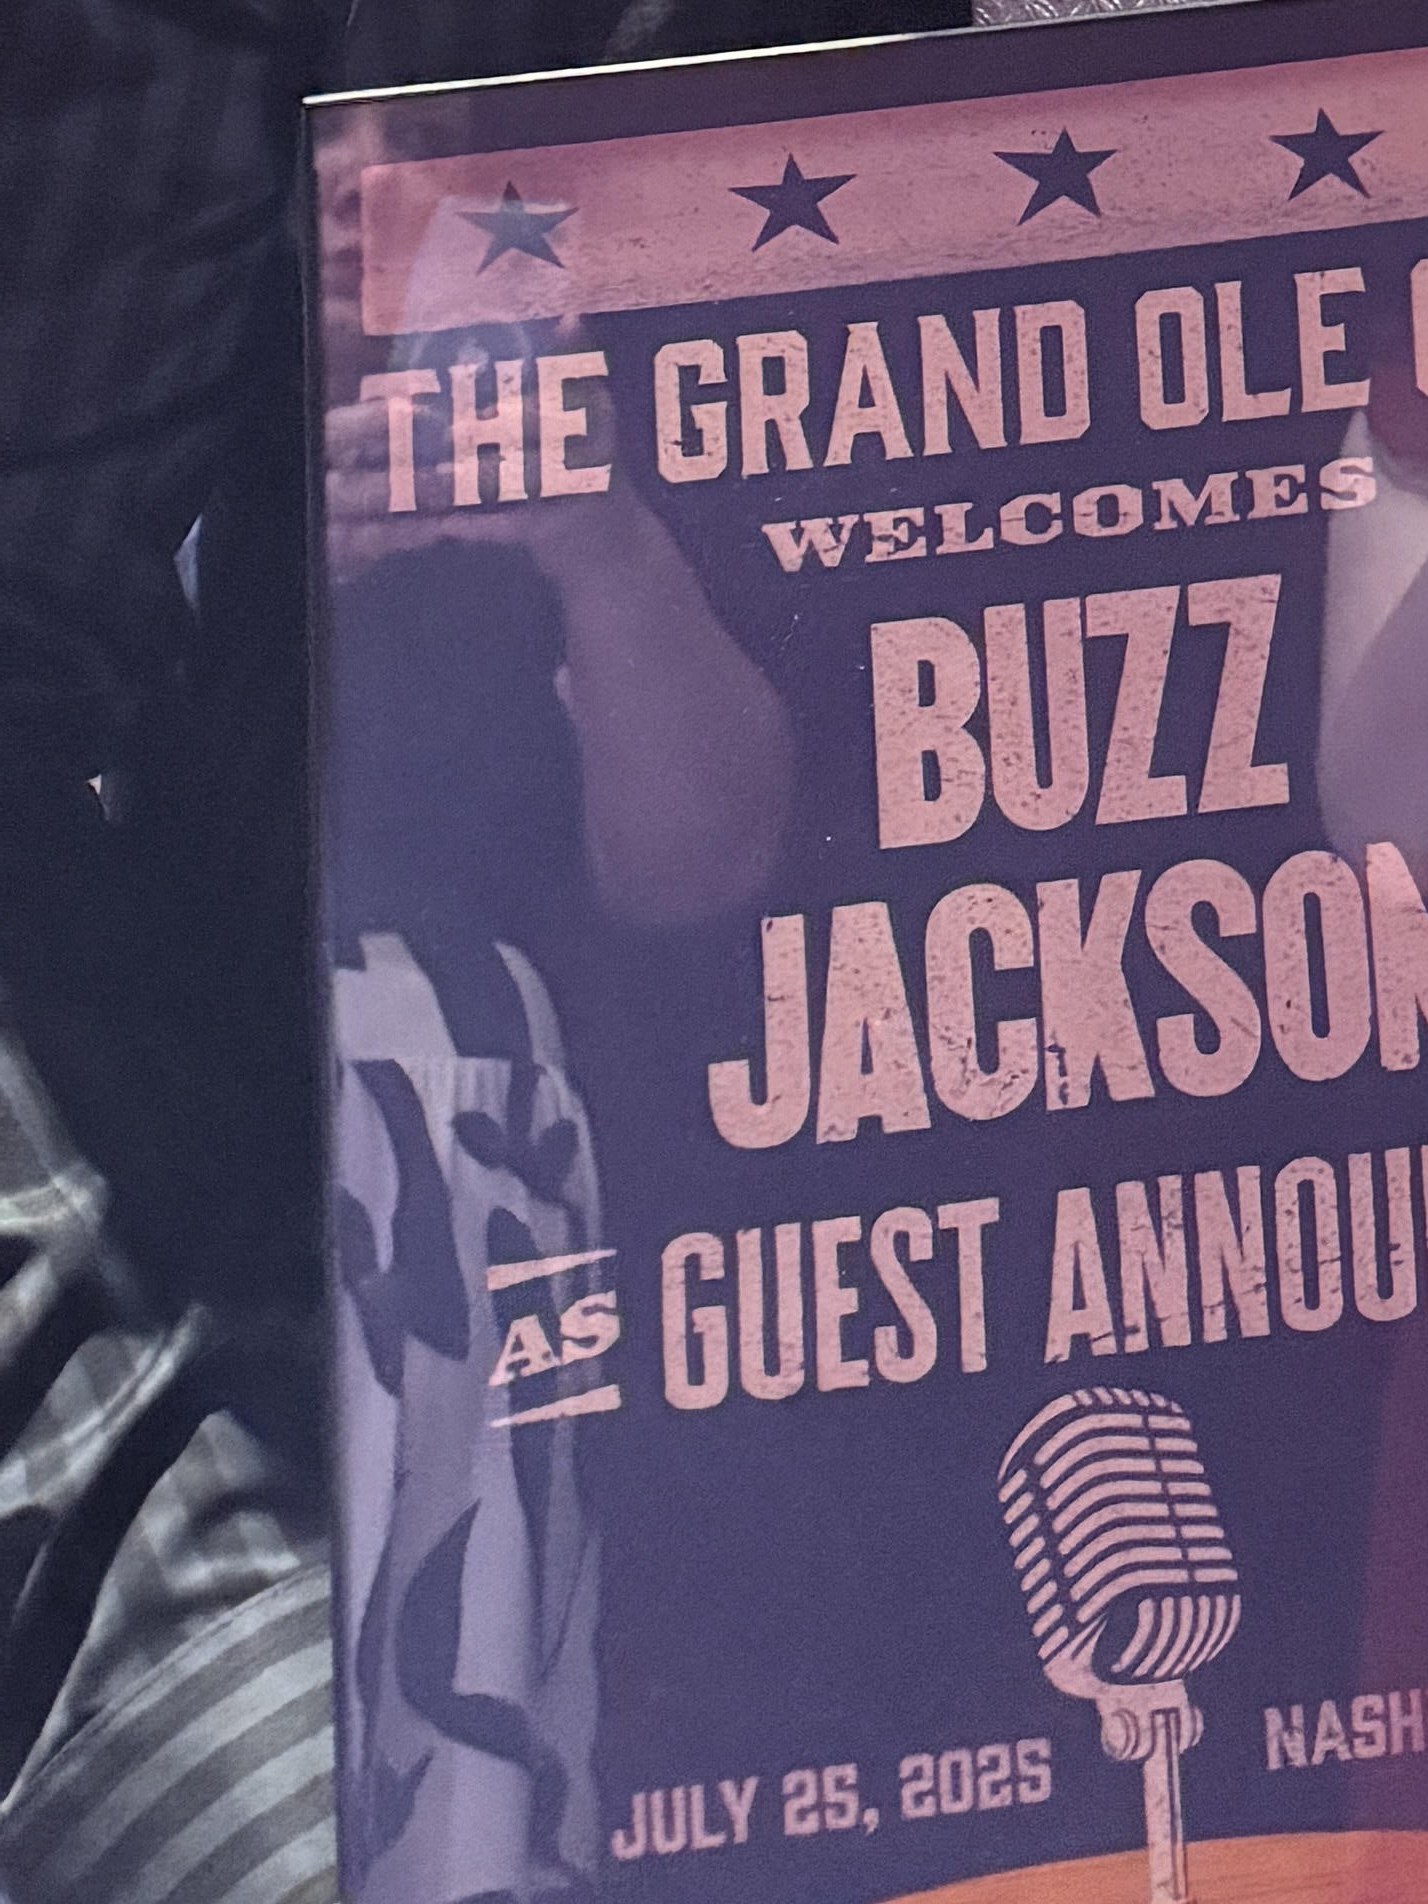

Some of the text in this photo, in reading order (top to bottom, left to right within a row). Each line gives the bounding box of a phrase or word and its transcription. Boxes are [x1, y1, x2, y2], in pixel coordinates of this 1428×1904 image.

[361, 350, 612, 512] THE
[653, 298, 1094, 484] GRAND
[1136, 264, 1370, 432] OLE
[760, 457, 1379, 574] WELCOMES
[870, 574, 1292, 850] BUZZ
[489, 1290, 622, 1388] AS
[661, 1198, 1004, 1414] GUEST
[610, 1735, 1055, 1862] JULY 25, 2025
